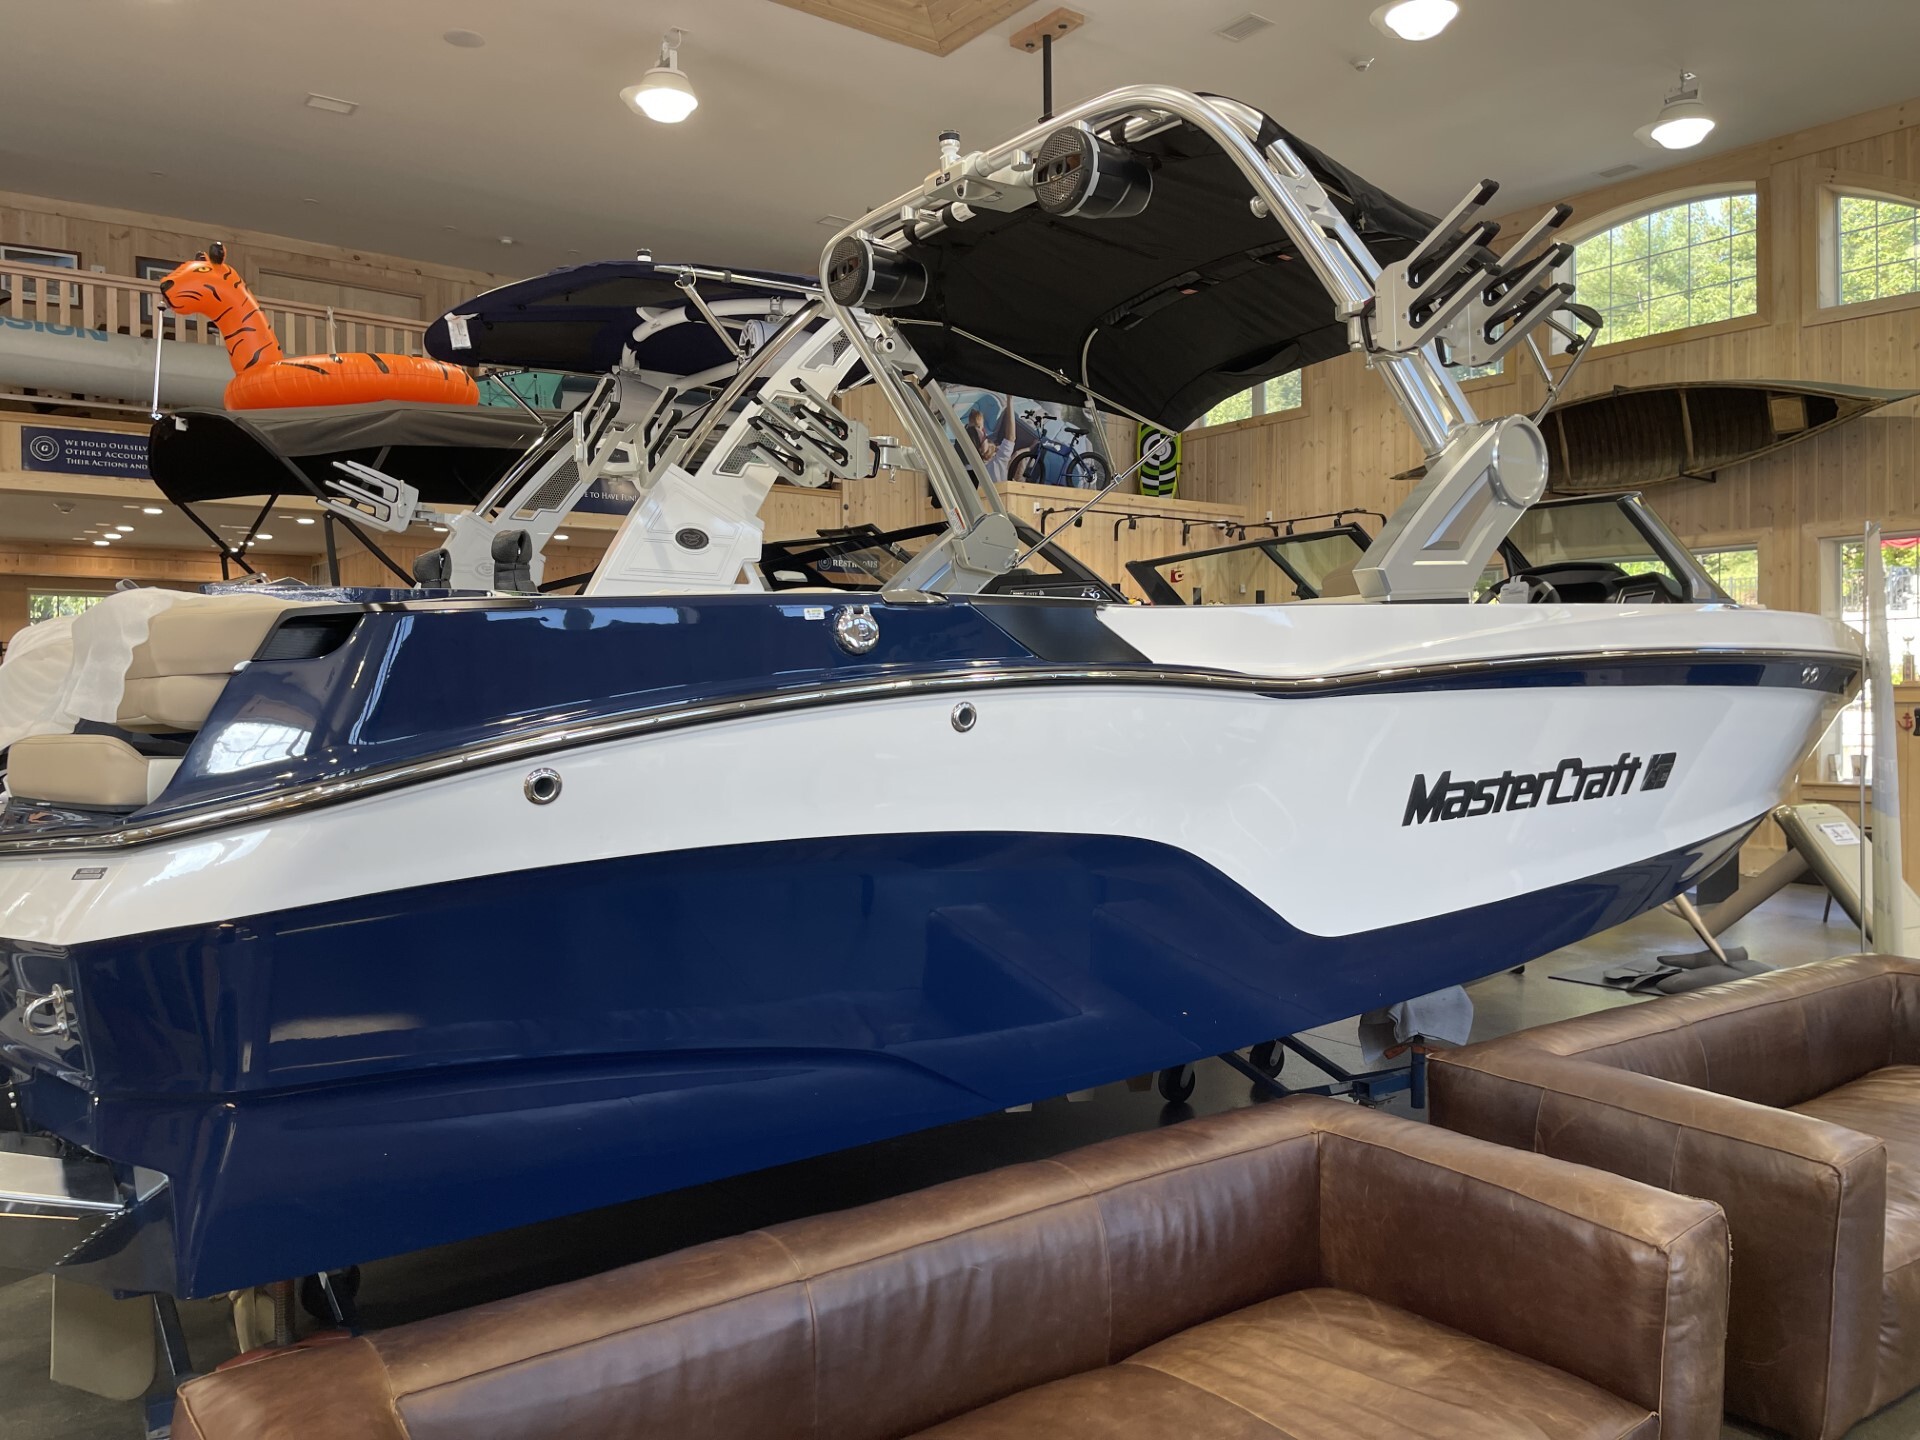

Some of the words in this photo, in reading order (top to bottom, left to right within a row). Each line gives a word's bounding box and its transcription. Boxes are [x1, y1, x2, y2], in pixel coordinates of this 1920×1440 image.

[80, 440, 107, 448] HOLD
[65, 448, 102, 457] OTHERS
[65, 457, 90, 466] THEIR
[92, 459, 128, 469] ACTIONS
[590, 491, 600, 499] TO
[601, 492, 619, 501] HAVE
[621, 493, 637, 502] FUN!
[1401, 752, 1643, 827] MasterCraft
